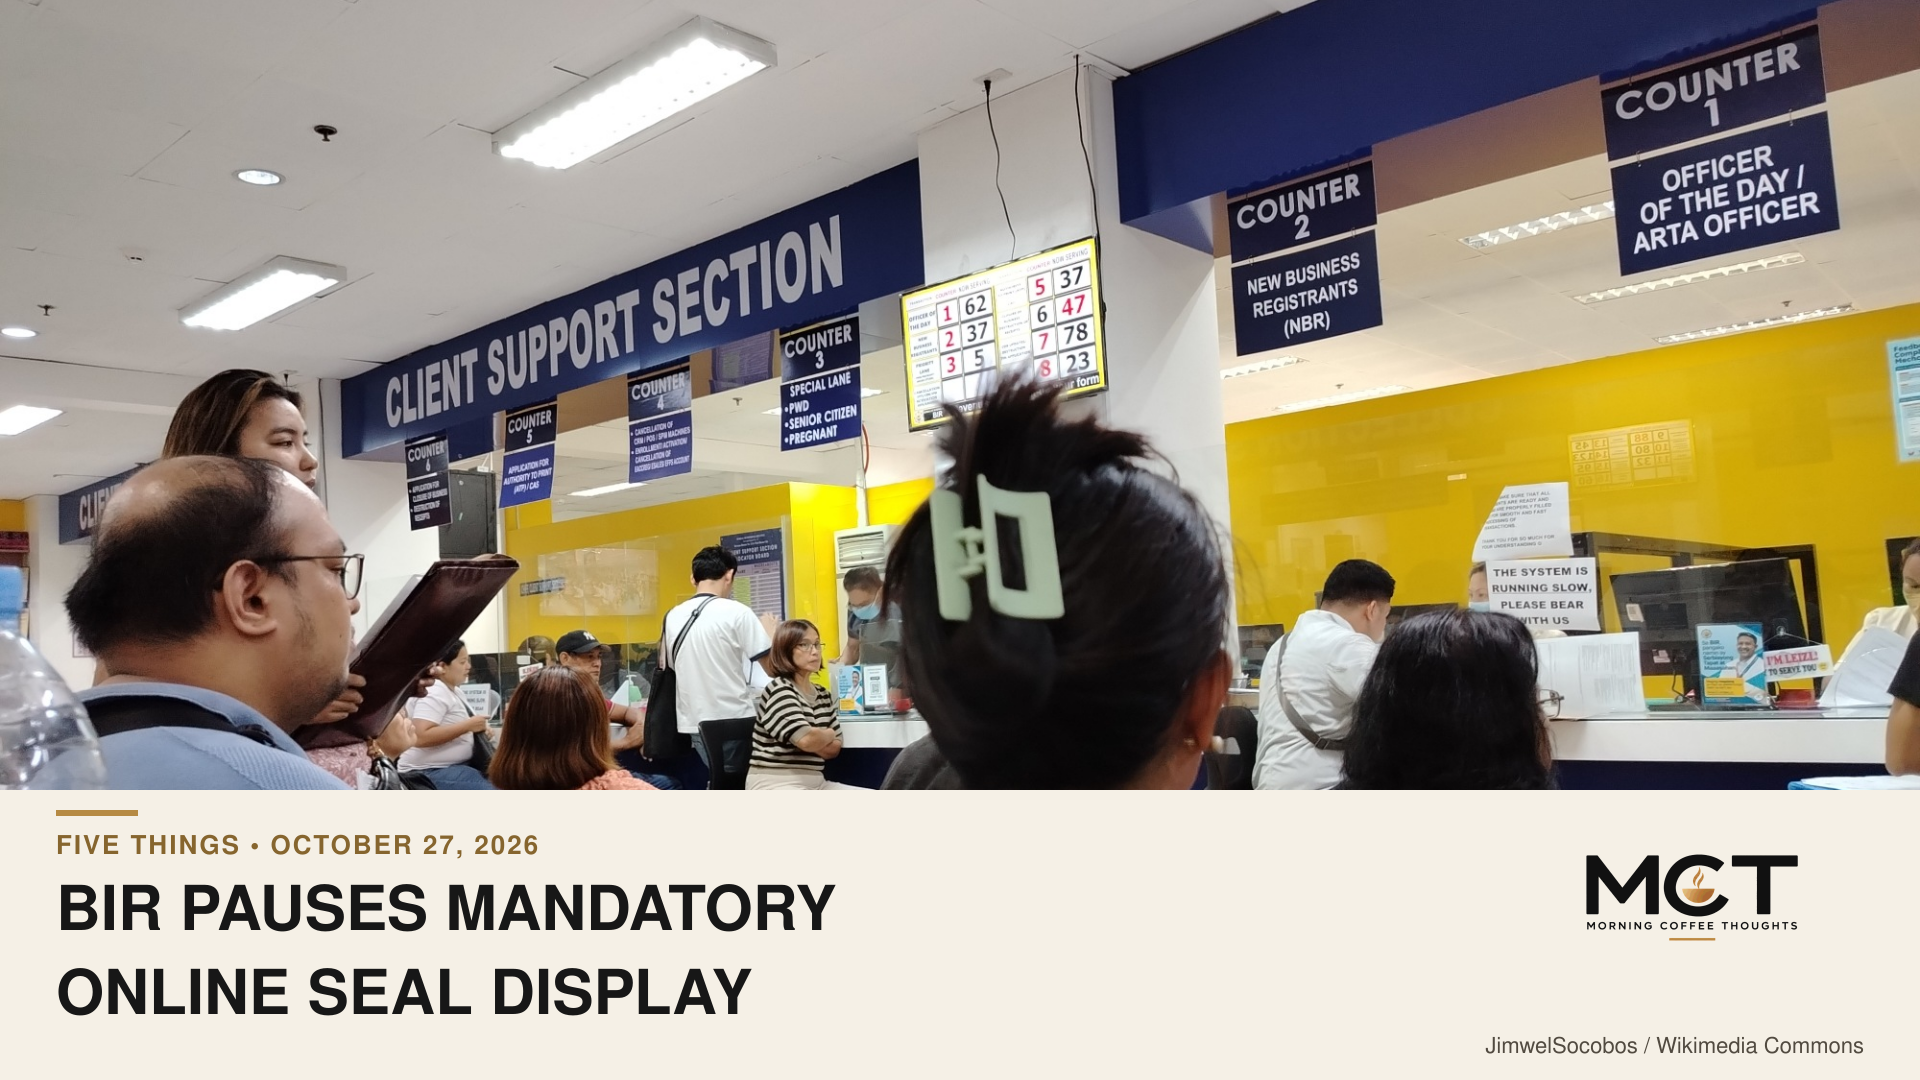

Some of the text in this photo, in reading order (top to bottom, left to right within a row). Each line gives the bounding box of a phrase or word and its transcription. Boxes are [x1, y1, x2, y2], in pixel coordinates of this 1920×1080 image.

[1615, 42, 1800, 120] COUNTER
[1704, 98, 1720, 127] 1
[1662, 145, 1774, 192] OFFICER
[1236, 173, 1360, 230] COUNTER
[1640, 164, 1805, 224] OF THE DAY /
[1294, 214, 1310, 240] 2
[1634, 192, 1820, 254] ARTA OFFICER
[1035, 278, 1045, 296] 5
[1060, 266, 1083, 289] 37
[1247, 252, 1360, 296] NEW BUSINESS
[944, 294, 986, 322] 1 62
[1037, 305, 1048, 322] 6
[1062, 294, 1086, 316] 47
[1253, 278, 1358, 318] REGISTRANTS
[386, 348, 478, 428] CLIENT
[487, 289, 641, 395] SUPPORT
[652, 214, 844, 344] SECTION
[909, 313, 928, 322] OFFICER
[1284, 310, 1330, 339] (NBR)
[784, 324, 852, 358] COUNTER
[945, 331, 954, 347] 2
[967, 321, 988, 342] 37
[1039, 322, 1088, 350] 7 78
[815, 350, 824, 369] 3
[946, 356, 956, 373] 3
[975, 349, 984, 366] 5
[1040, 351, 1090, 377] 8 23
[632, 372, 685, 400] COUNTER
[790, 371, 851, 397] SPECIAL LANE
[1076, 375, 1099, 387] form
[657, 395, 664, 410] 4
[789, 400, 809, 414] PWD
[508, 410, 552, 434] COUNTER
[634, 423, 666, 436] CANCELLATION
[789, 404, 857, 430] SENIOR CITIZEN
[527, 429, 532, 444] 5
[668, 426, 690, 437] MACHINES
[789, 425, 838, 445] PREGNANT
[408, 442, 445, 462] COUNTER
[635, 452, 664, 464] CANCELLATION
[426, 461, 431, 472] 6
[503, 467, 552, 485] AUTHORITY TO PRINT
[508, 458, 549, 474] APPLICATION FOR
[1521, 567, 1571, 576] SYSTEM
[1576, 567, 1588, 575] IS
[1492, 583, 1592, 593] RUNNING SLOW,
[1501, 601, 1584, 609] PLEASE BEAR
[1766, 655, 1783, 666] I'M
[1780, 666, 1801, 674] SERVE
